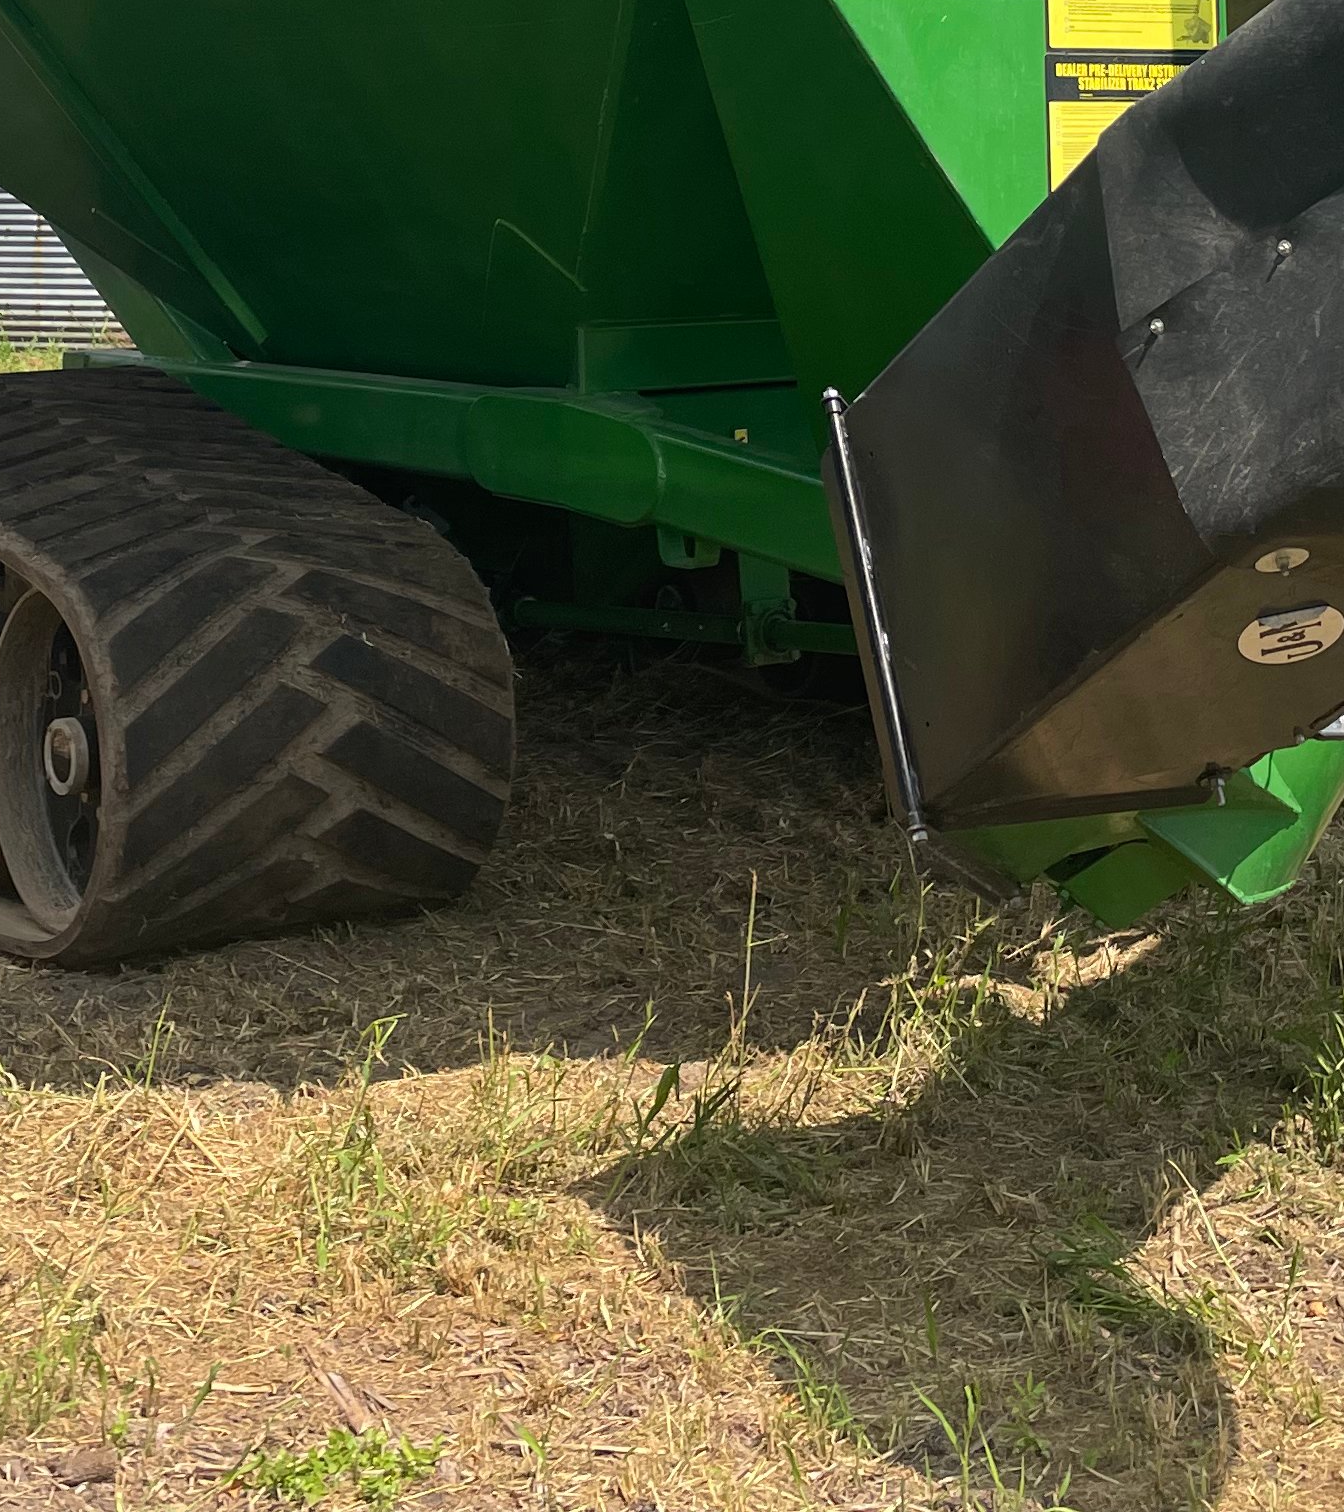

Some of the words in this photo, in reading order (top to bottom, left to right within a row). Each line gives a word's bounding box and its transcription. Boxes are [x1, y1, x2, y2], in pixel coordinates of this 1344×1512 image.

[1055, 62, 1088, 77] DEALER
[1088, 63, 1148, 78] PRE-DELIVERY
[1078, 77, 1126, 90] STABILIZER
